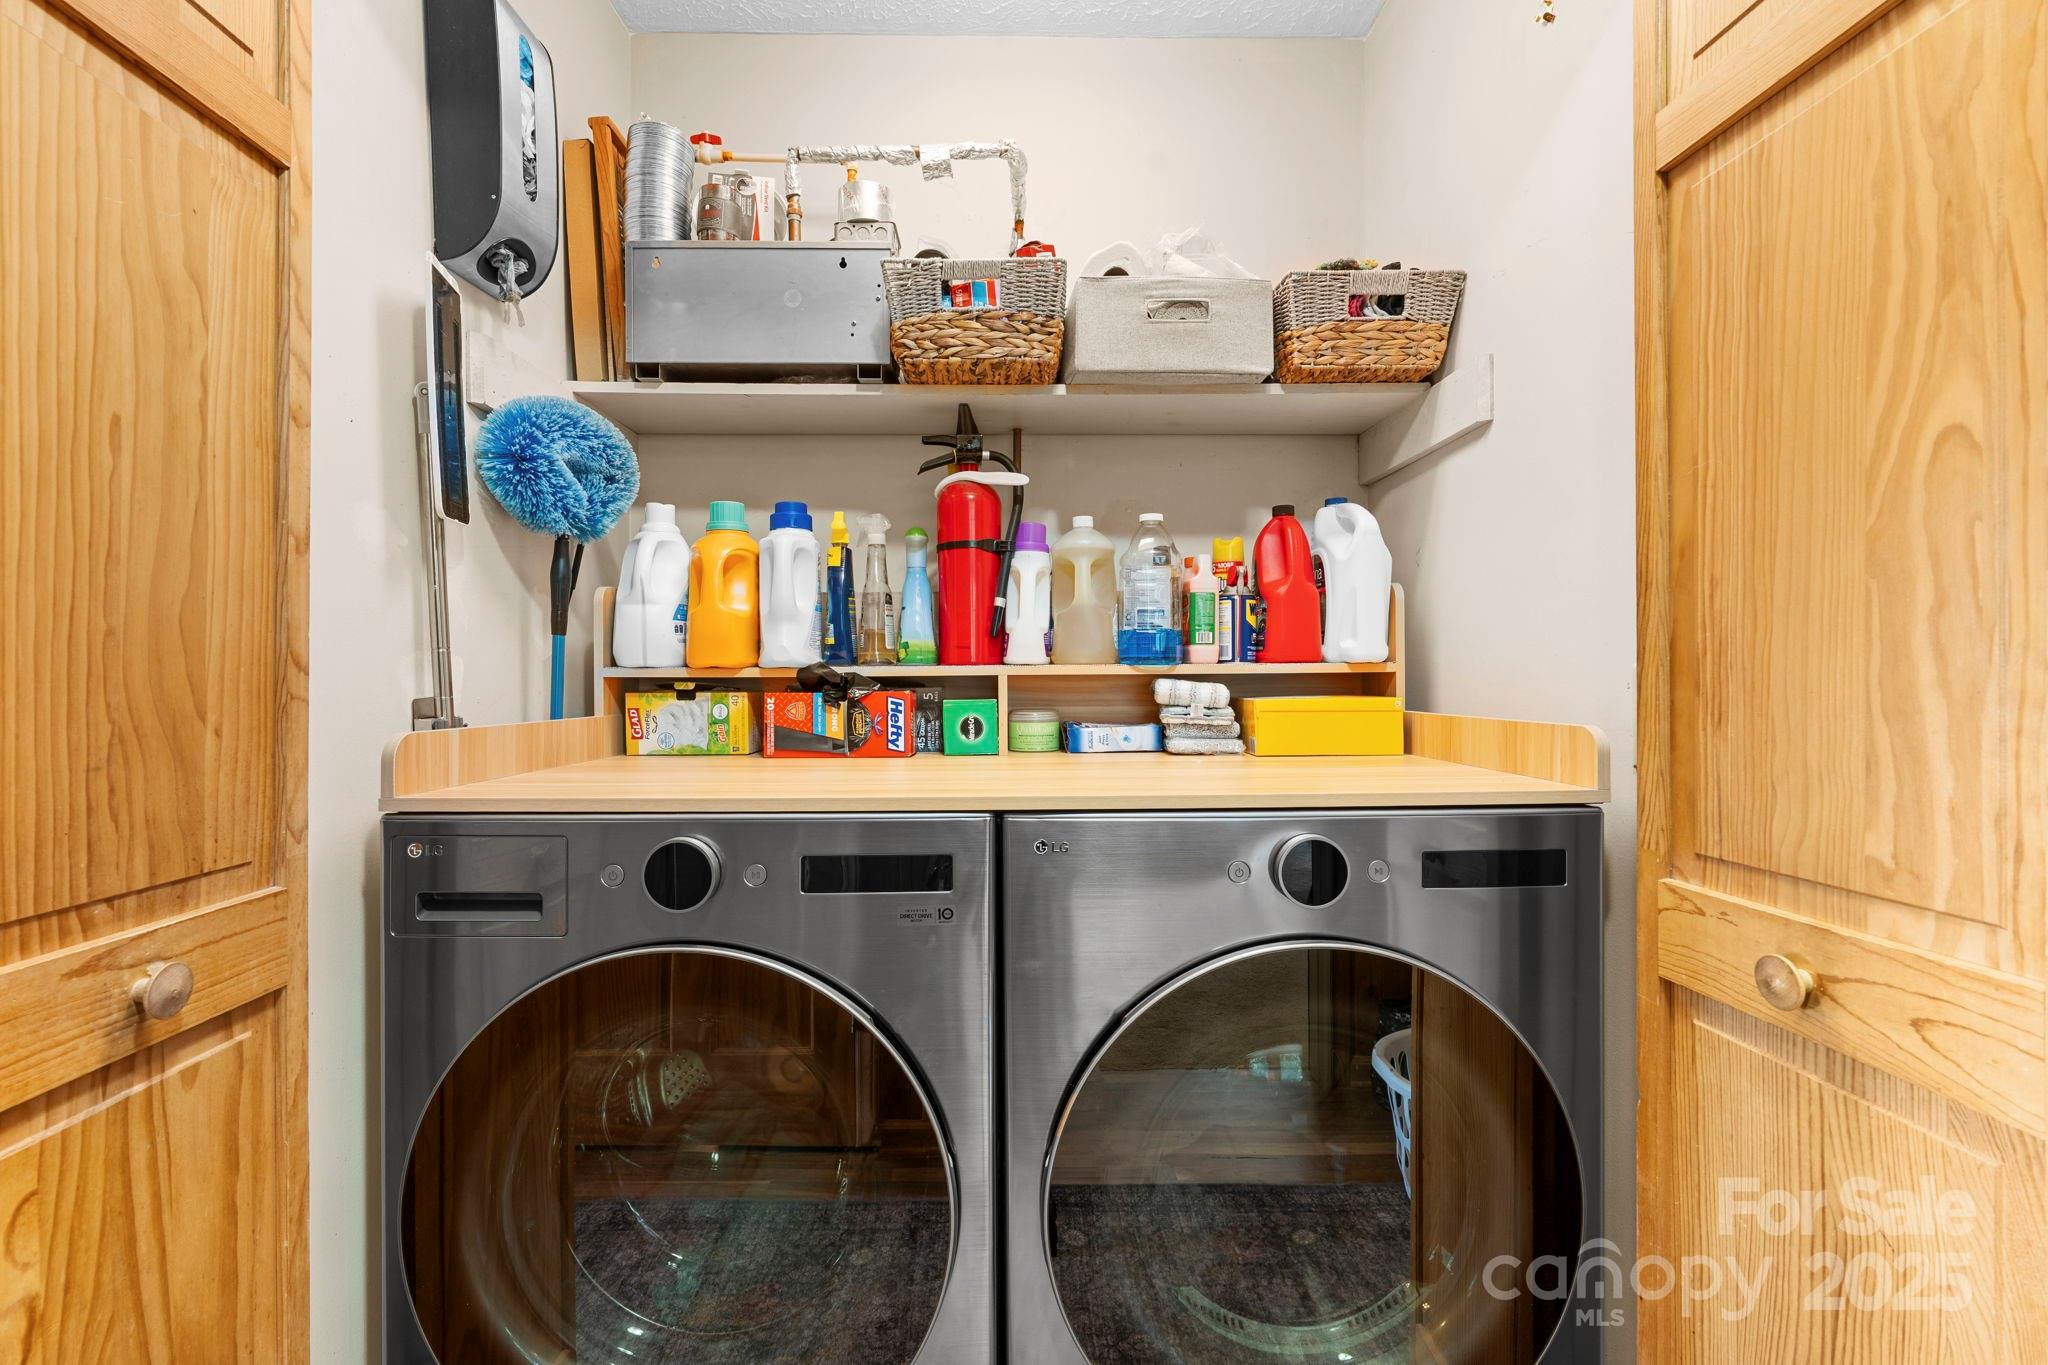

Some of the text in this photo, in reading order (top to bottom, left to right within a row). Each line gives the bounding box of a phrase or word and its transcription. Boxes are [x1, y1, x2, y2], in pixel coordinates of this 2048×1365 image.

[731, 695, 740, 706] 40
[923, 692, 934, 700] 5
[767, 698, 774, 710] 20
[629, 709, 642, 738] GLAD
[644, 710, 652, 740] ForceFlex
[888, 700, 903, 750] Hefty
[717, 724, 727, 743] Gain
[917, 737, 926, 750] 45
[1051, 841, 1070, 853] LG
[938, 908, 953, 920] 10
